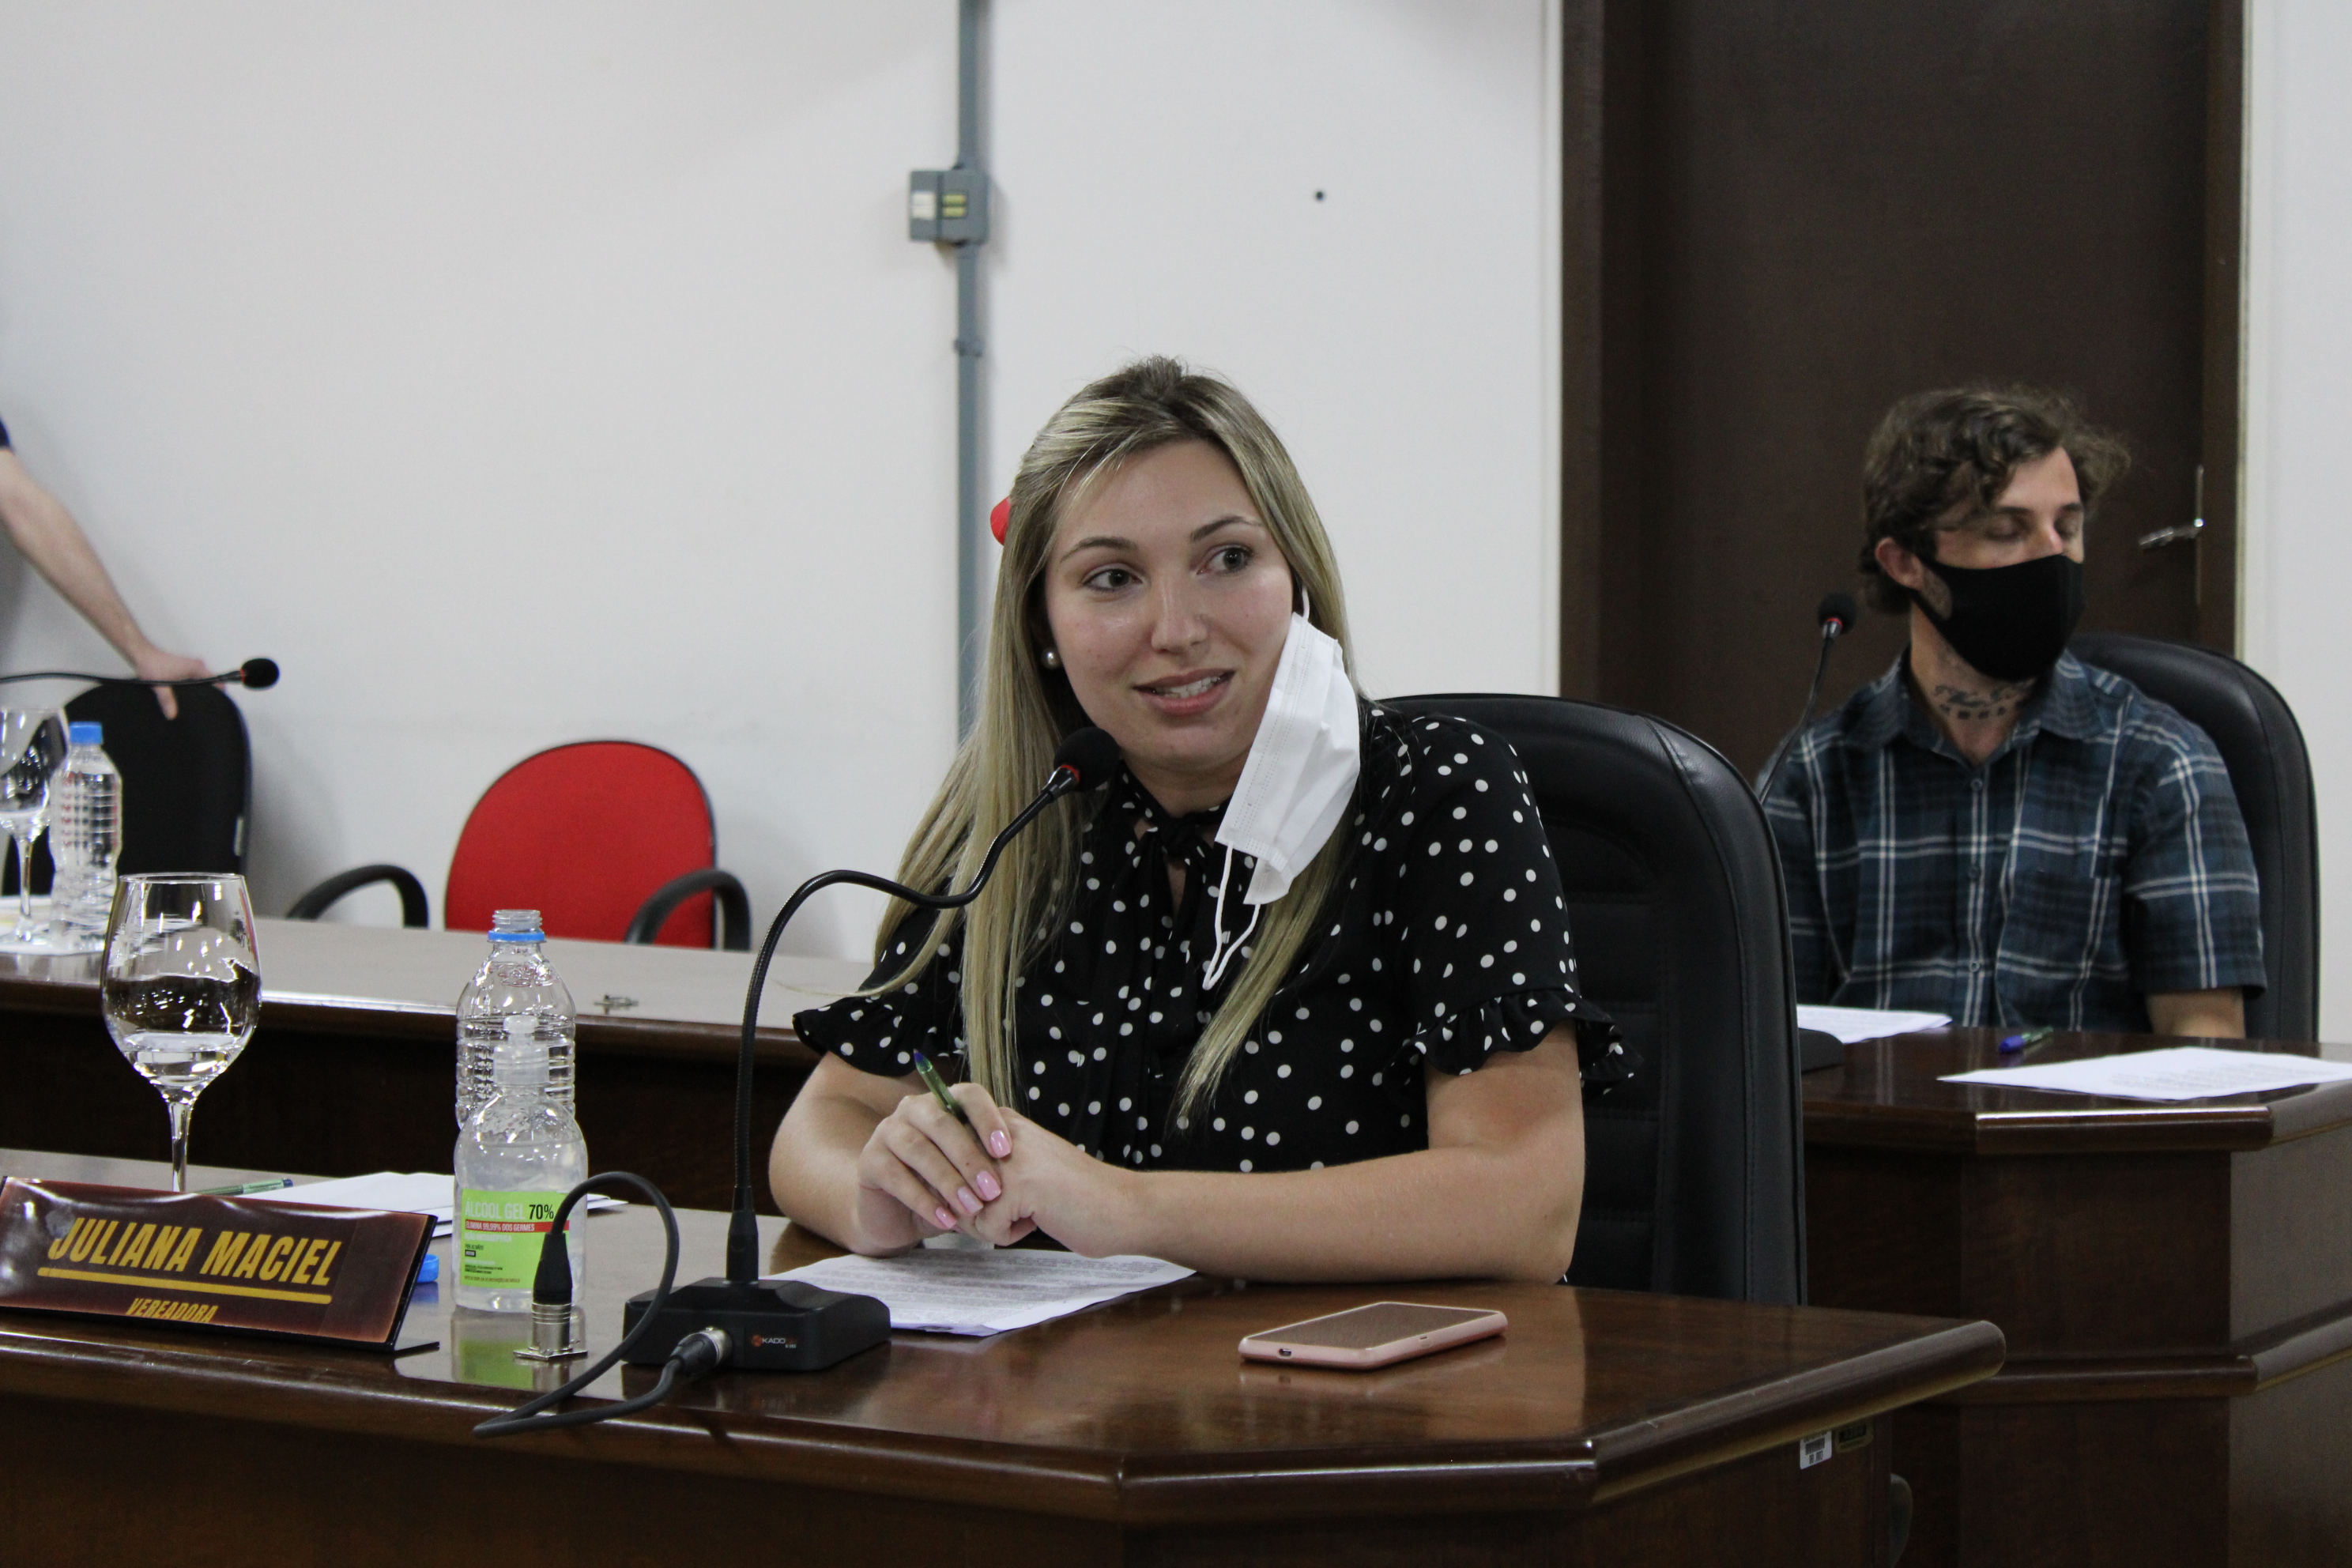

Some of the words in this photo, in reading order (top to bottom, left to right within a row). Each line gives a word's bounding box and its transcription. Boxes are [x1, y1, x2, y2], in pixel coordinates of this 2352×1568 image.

[464, 1197, 501, 1219] ÁLCOOL
[504, 1204, 526, 1219] GEL
[529, 1204, 555, 1219] 70%
[502, 1223, 513, 1231] DOS
[513, 1223, 535, 1232] GERMES
[47, 1217, 203, 1272] JULIANA
[200, 1231, 342, 1287] MACIEL
[125, 1297, 219, 1323] VEREADORA
